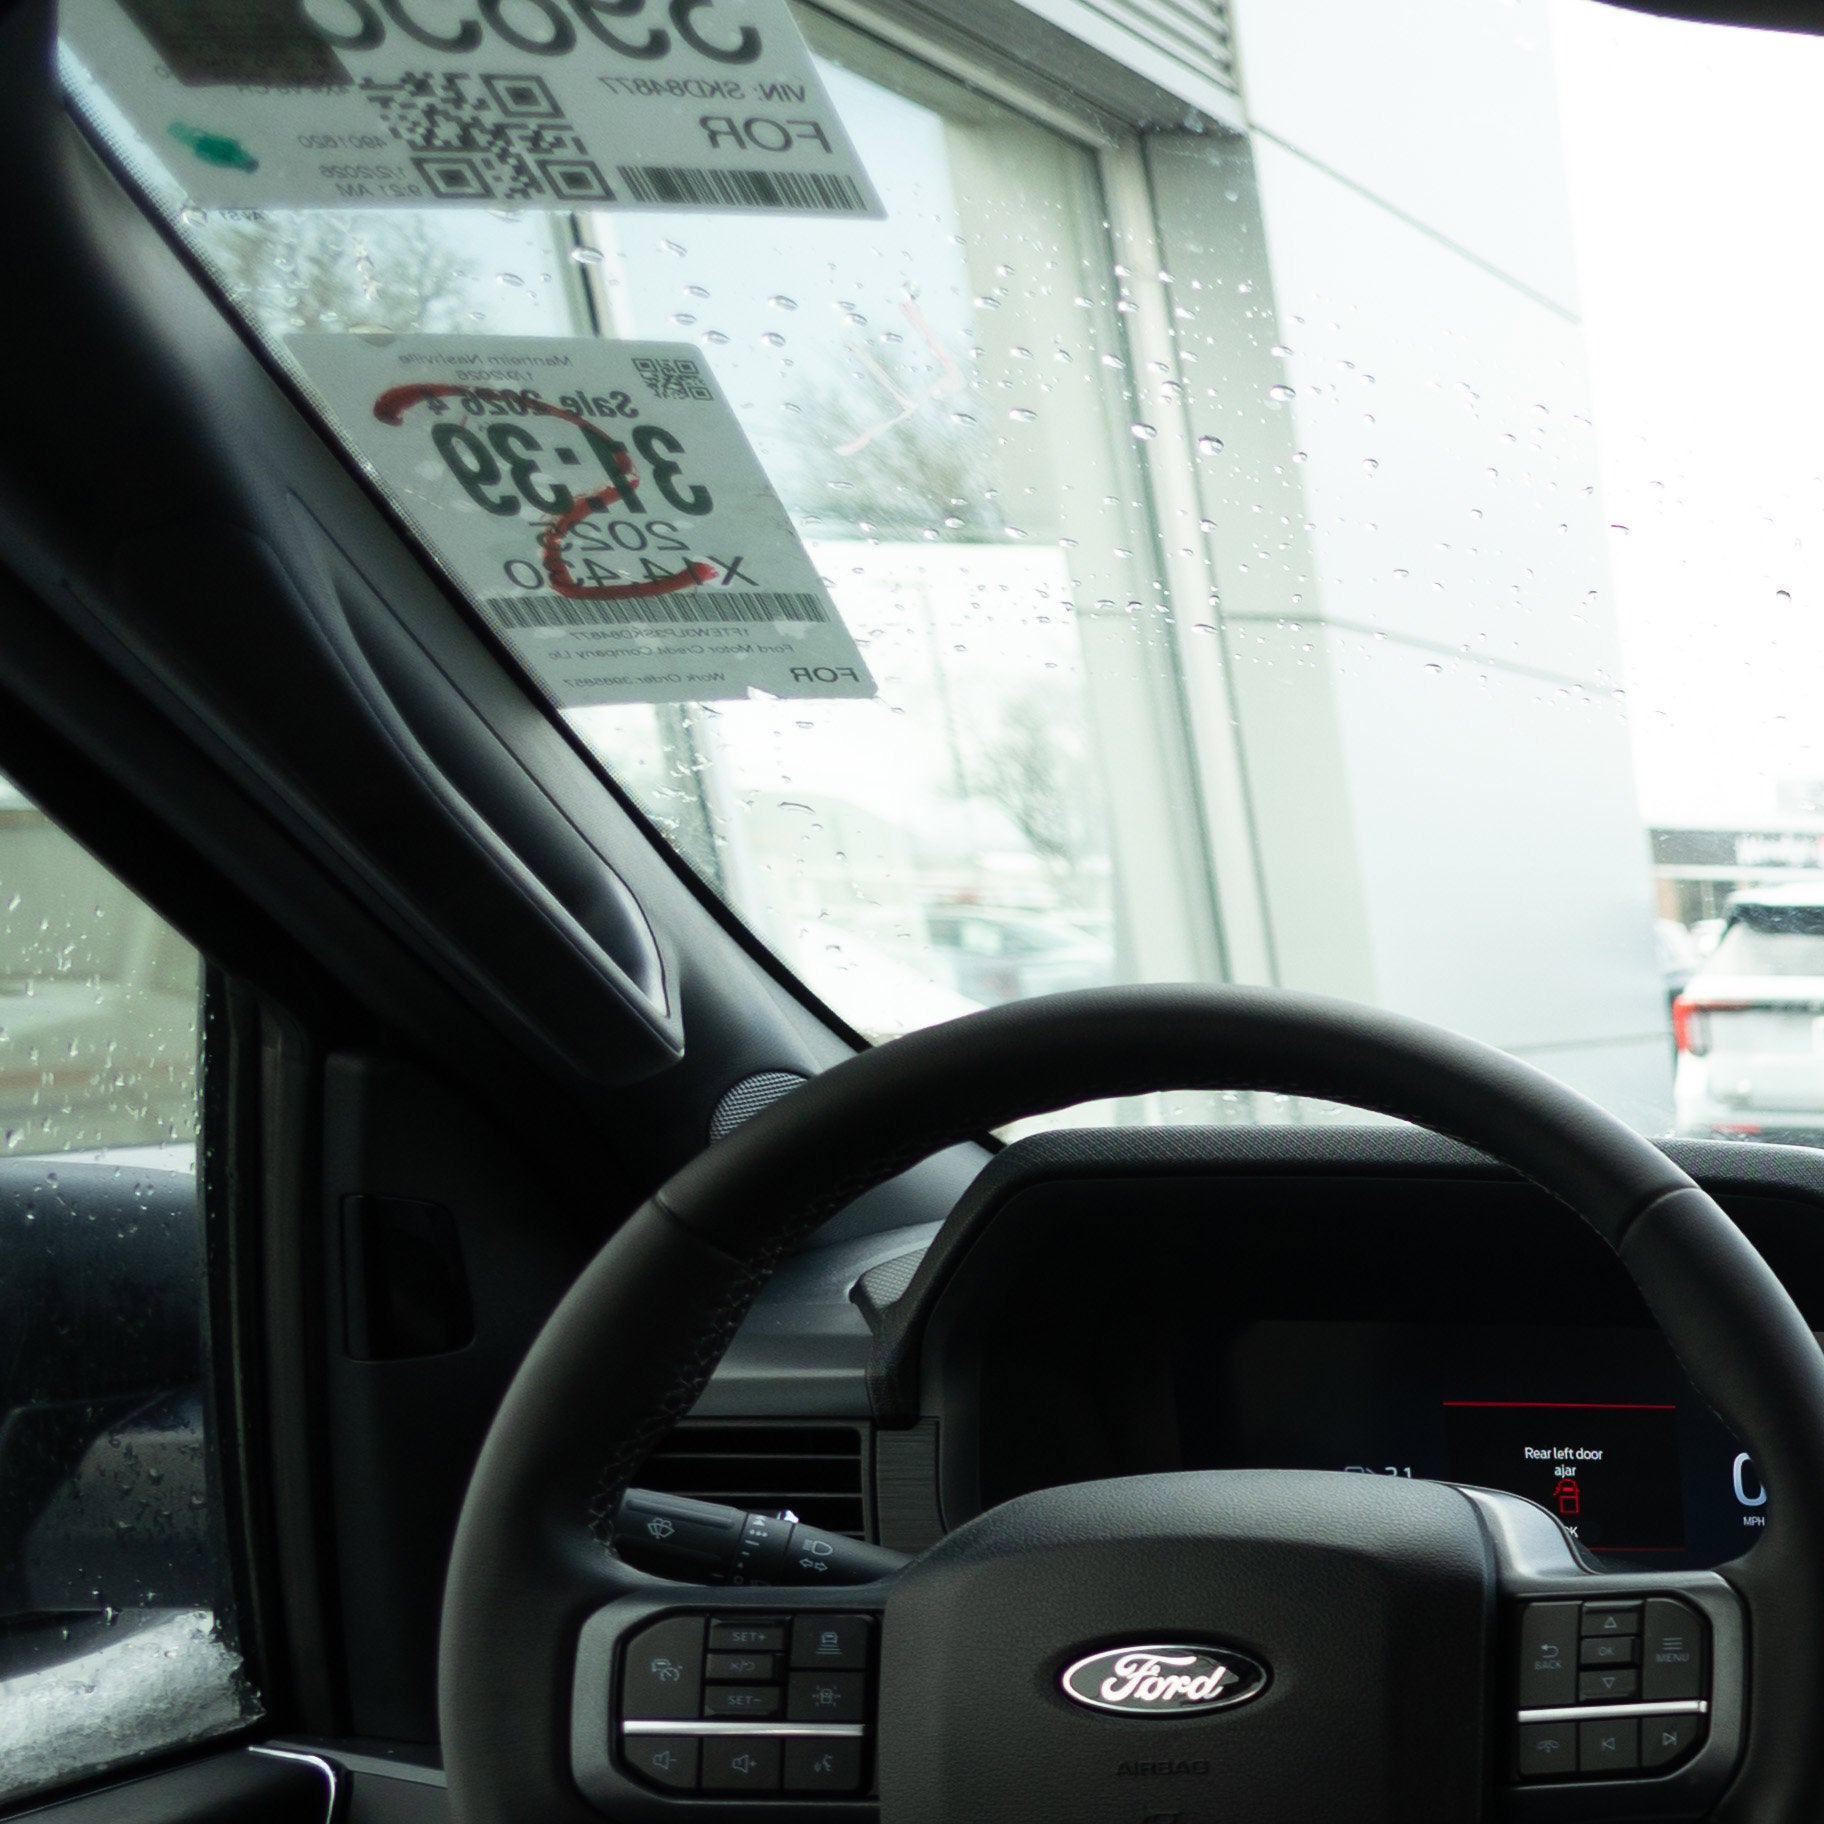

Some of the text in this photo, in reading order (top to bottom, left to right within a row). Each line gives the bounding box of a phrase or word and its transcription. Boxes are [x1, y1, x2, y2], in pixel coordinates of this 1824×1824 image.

[1524, 1447, 1603, 1461] Rear left door
[1554, 1464, 1576, 1478] ajar
[1743, 1516, 1765, 1527] MPH
[731, 1630, 768, 1644] SET+
[1599, 1646, 1615, 1656] OK
[1655, 1653, 1690, 1663] MENU
[1535, 1661, 1562, 1670] BACK
[1099, 1652, 1227, 1703] Ford
